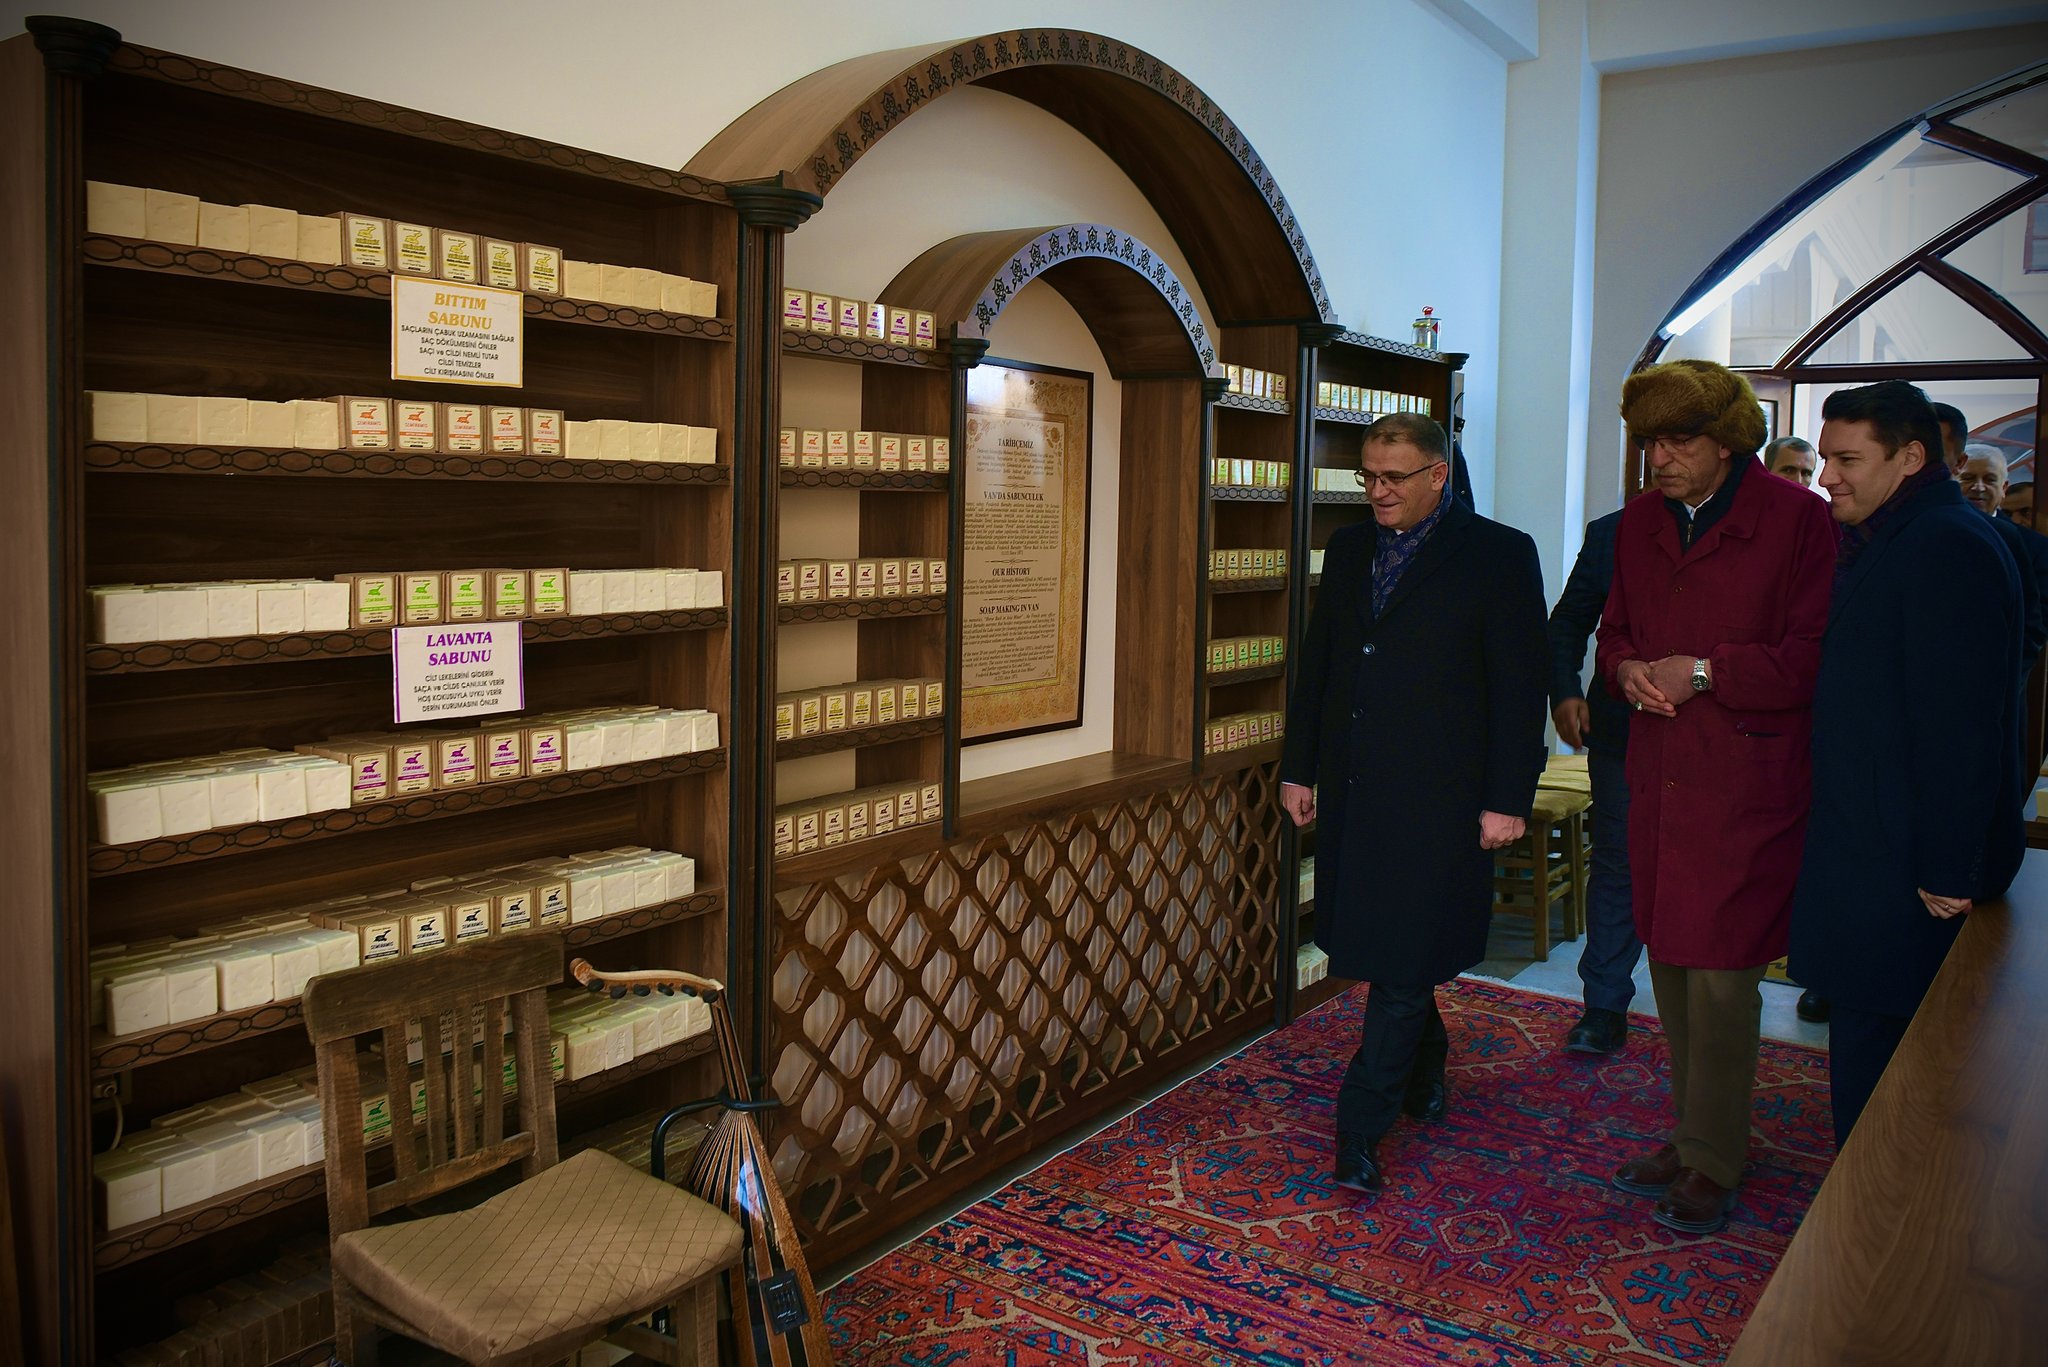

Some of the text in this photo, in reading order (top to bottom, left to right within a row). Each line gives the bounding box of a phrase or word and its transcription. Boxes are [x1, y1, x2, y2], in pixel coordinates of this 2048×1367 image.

[428, 311, 492, 329] SABUNU
[434, 328, 456, 337] ÇABUK
[421, 336, 435, 345] SAÇ
[482, 353, 499, 361] TUTAR
[992, 567, 1006, 577] OUR
[979, 603, 1040, 615] SOAP MAKING IN VAN
[426, 631, 492, 648] LAVANTA
[428, 649, 492, 667] SABUNU
